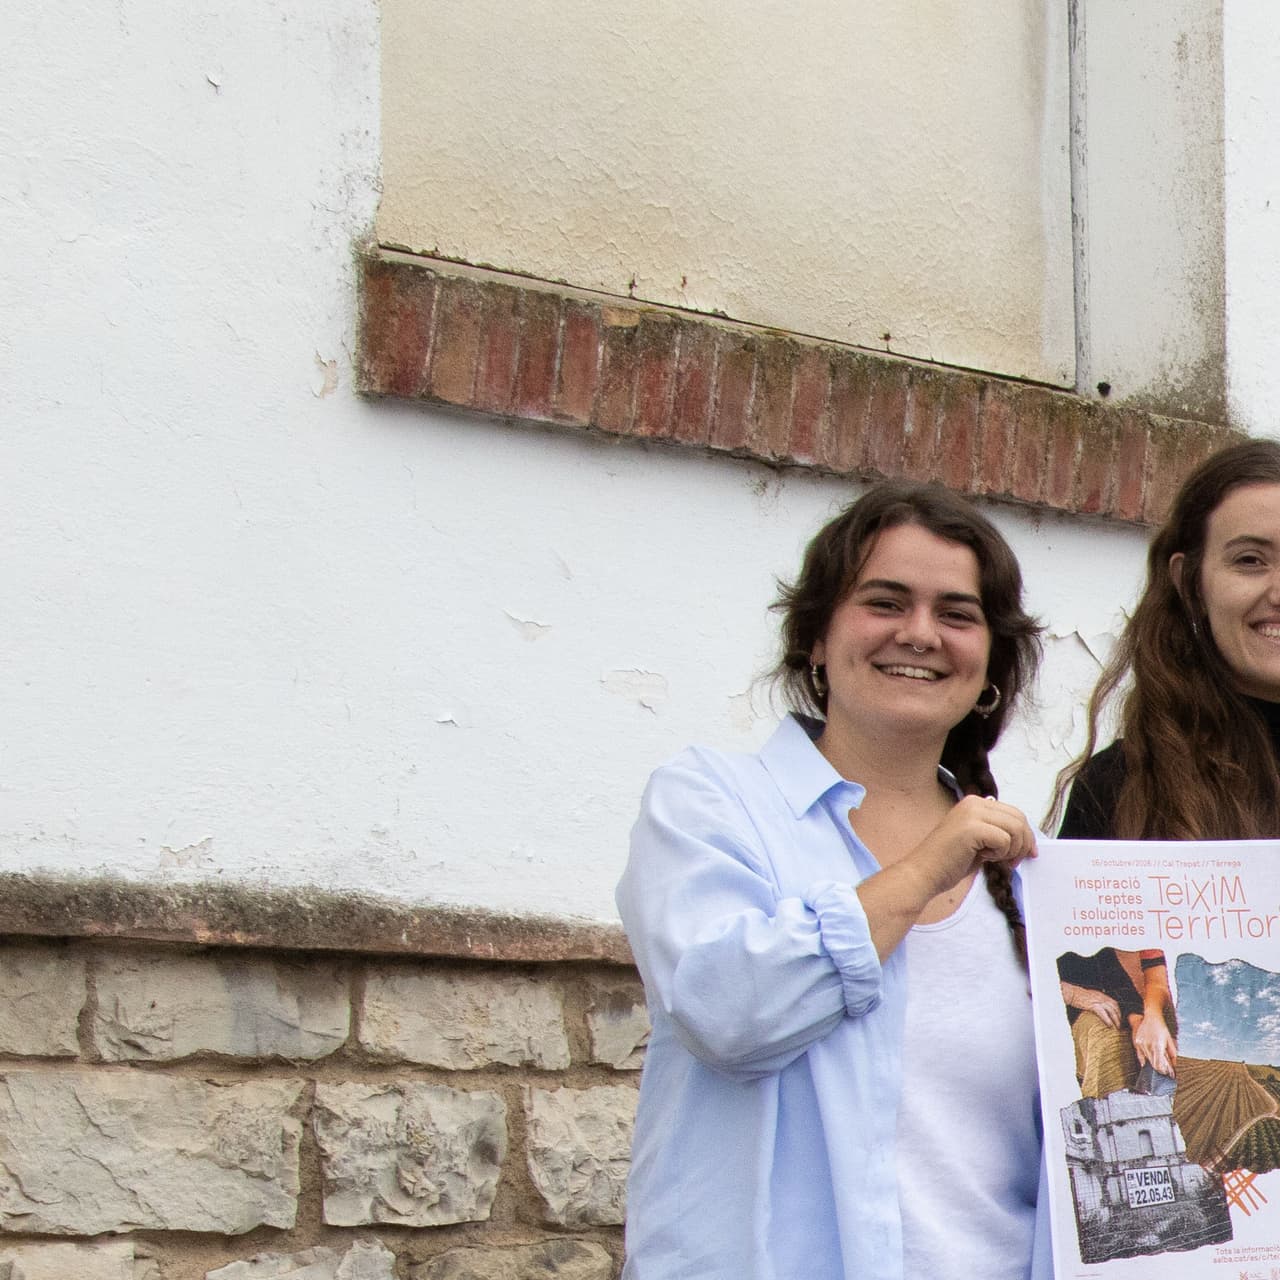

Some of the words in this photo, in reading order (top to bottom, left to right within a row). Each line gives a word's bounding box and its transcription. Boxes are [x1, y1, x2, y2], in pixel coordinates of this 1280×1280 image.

[1074, 875, 1141, 892] inspiració
[1098, 892, 1143, 908] reptes
[1072, 909, 1077, 920] i
[1080, 908, 1144, 921] solucions
[1063, 923, 1146, 939] comparides
[1135, 1170, 1170, 1187] VENDA
[1135, 1186, 1174, 1205] 22.05.43
